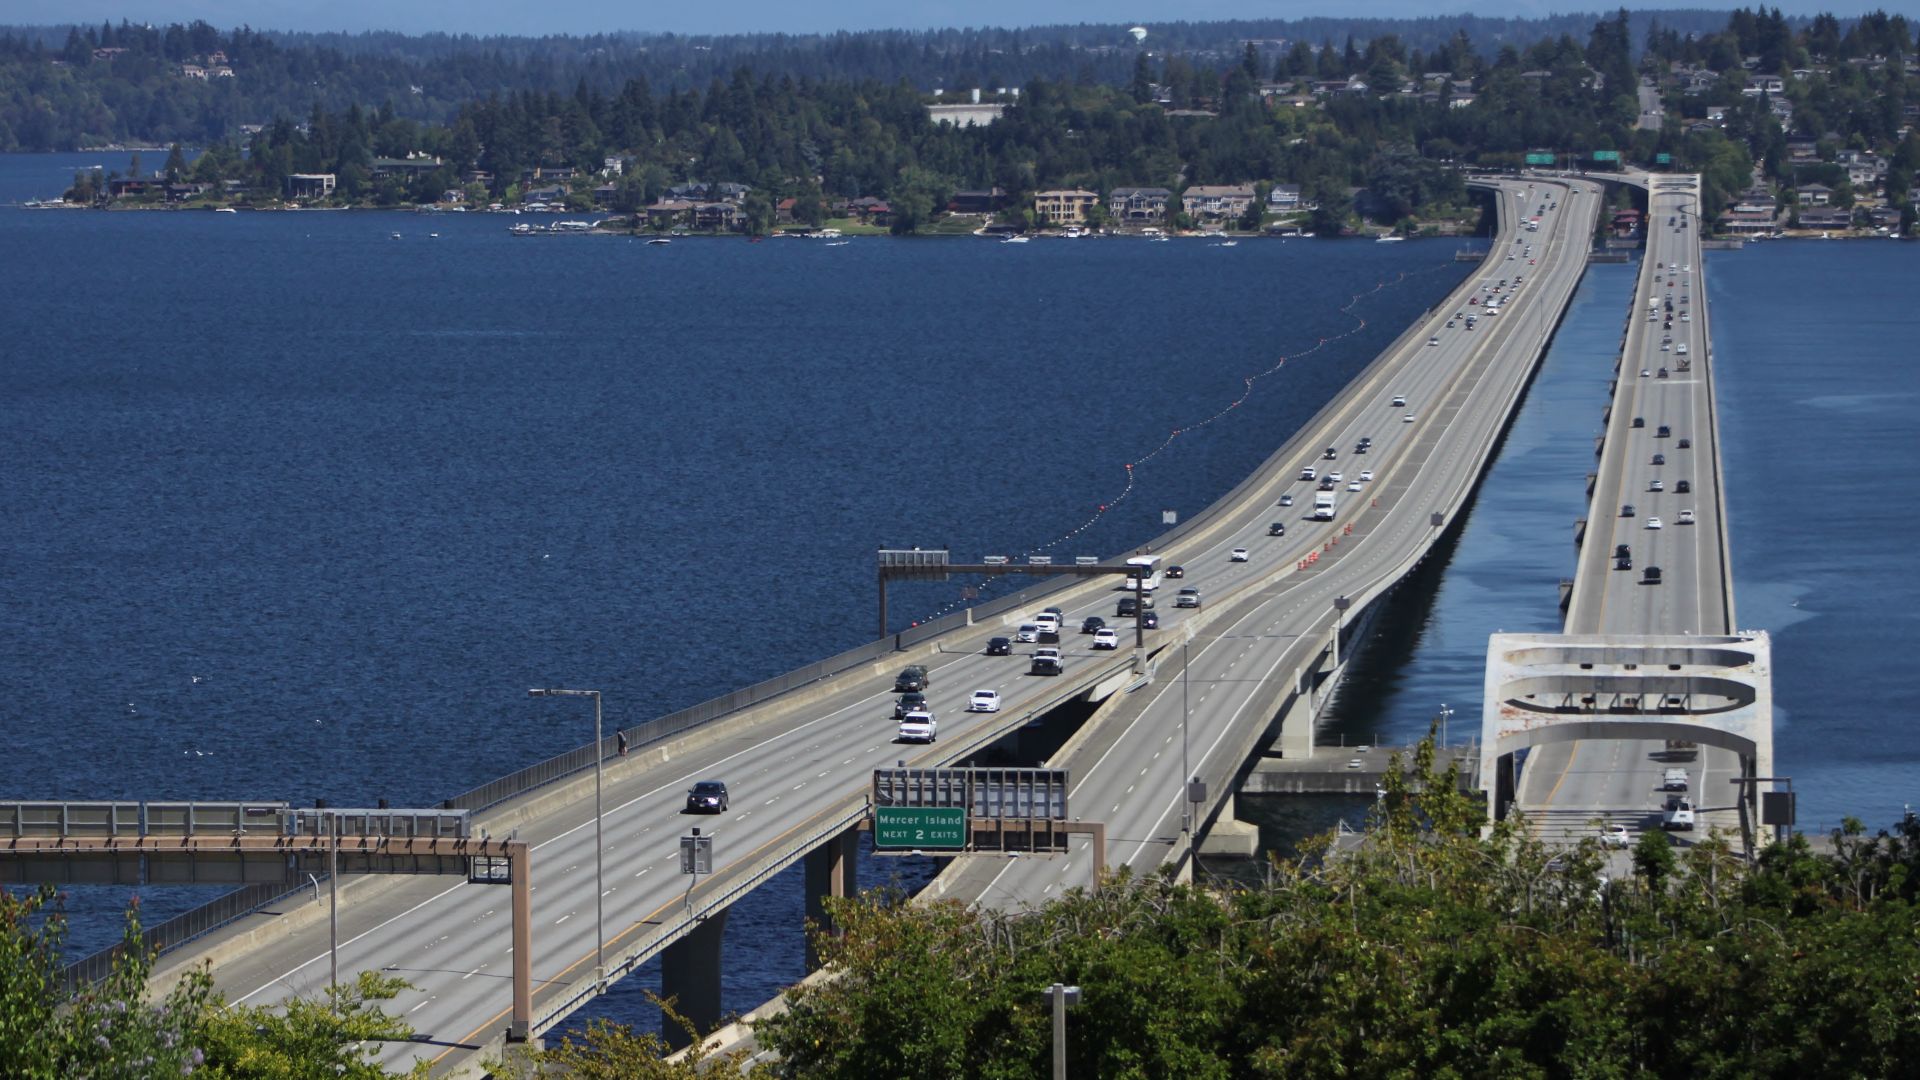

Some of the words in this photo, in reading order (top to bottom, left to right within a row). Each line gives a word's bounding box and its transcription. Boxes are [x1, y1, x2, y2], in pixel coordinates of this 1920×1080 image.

[880, 815, 919, 824] Mercer
[925, 816, 961, 825] Island
[915, 829, 924, 840] 2
